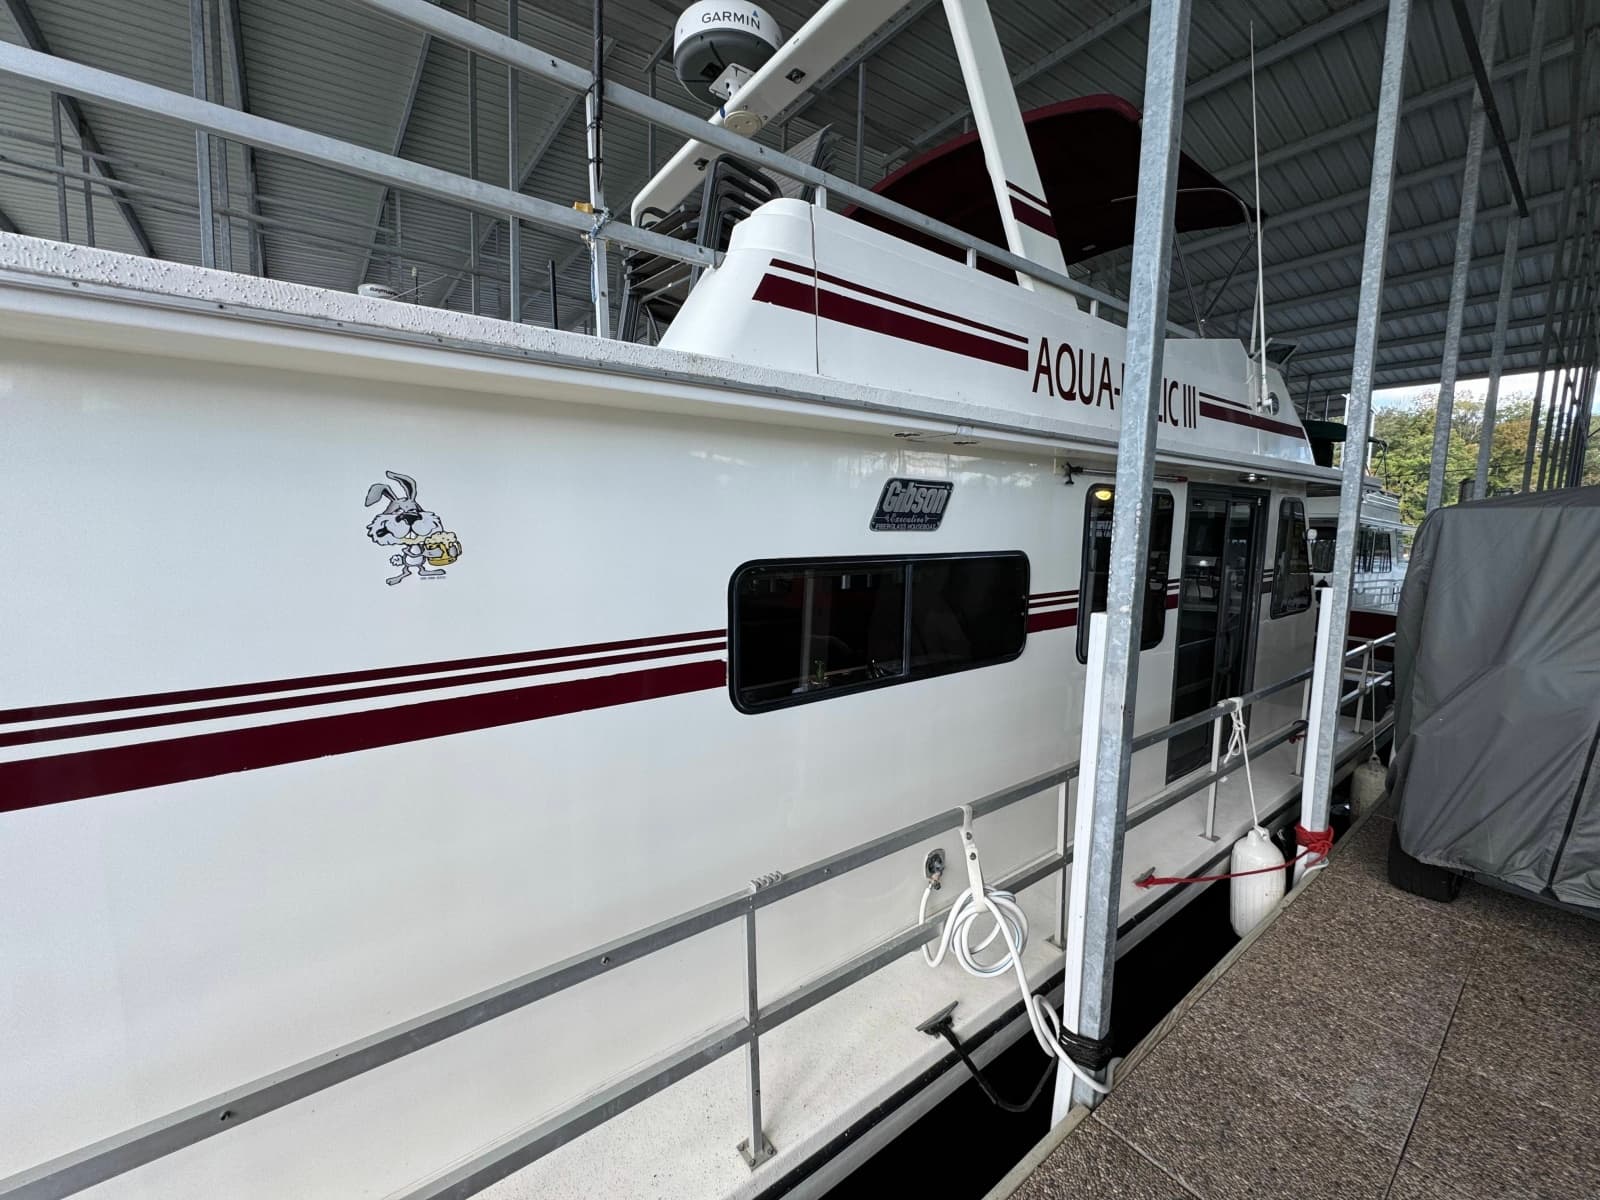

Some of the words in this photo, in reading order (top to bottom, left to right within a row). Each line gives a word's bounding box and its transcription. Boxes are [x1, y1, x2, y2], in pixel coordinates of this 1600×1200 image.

[701, 11, 760, 30] GARMIN
[1032, 336, 1179, 427] AQUA-IC
[1183, 383, 1197, 429] III
[883, 480, 948, 513] Gibson
